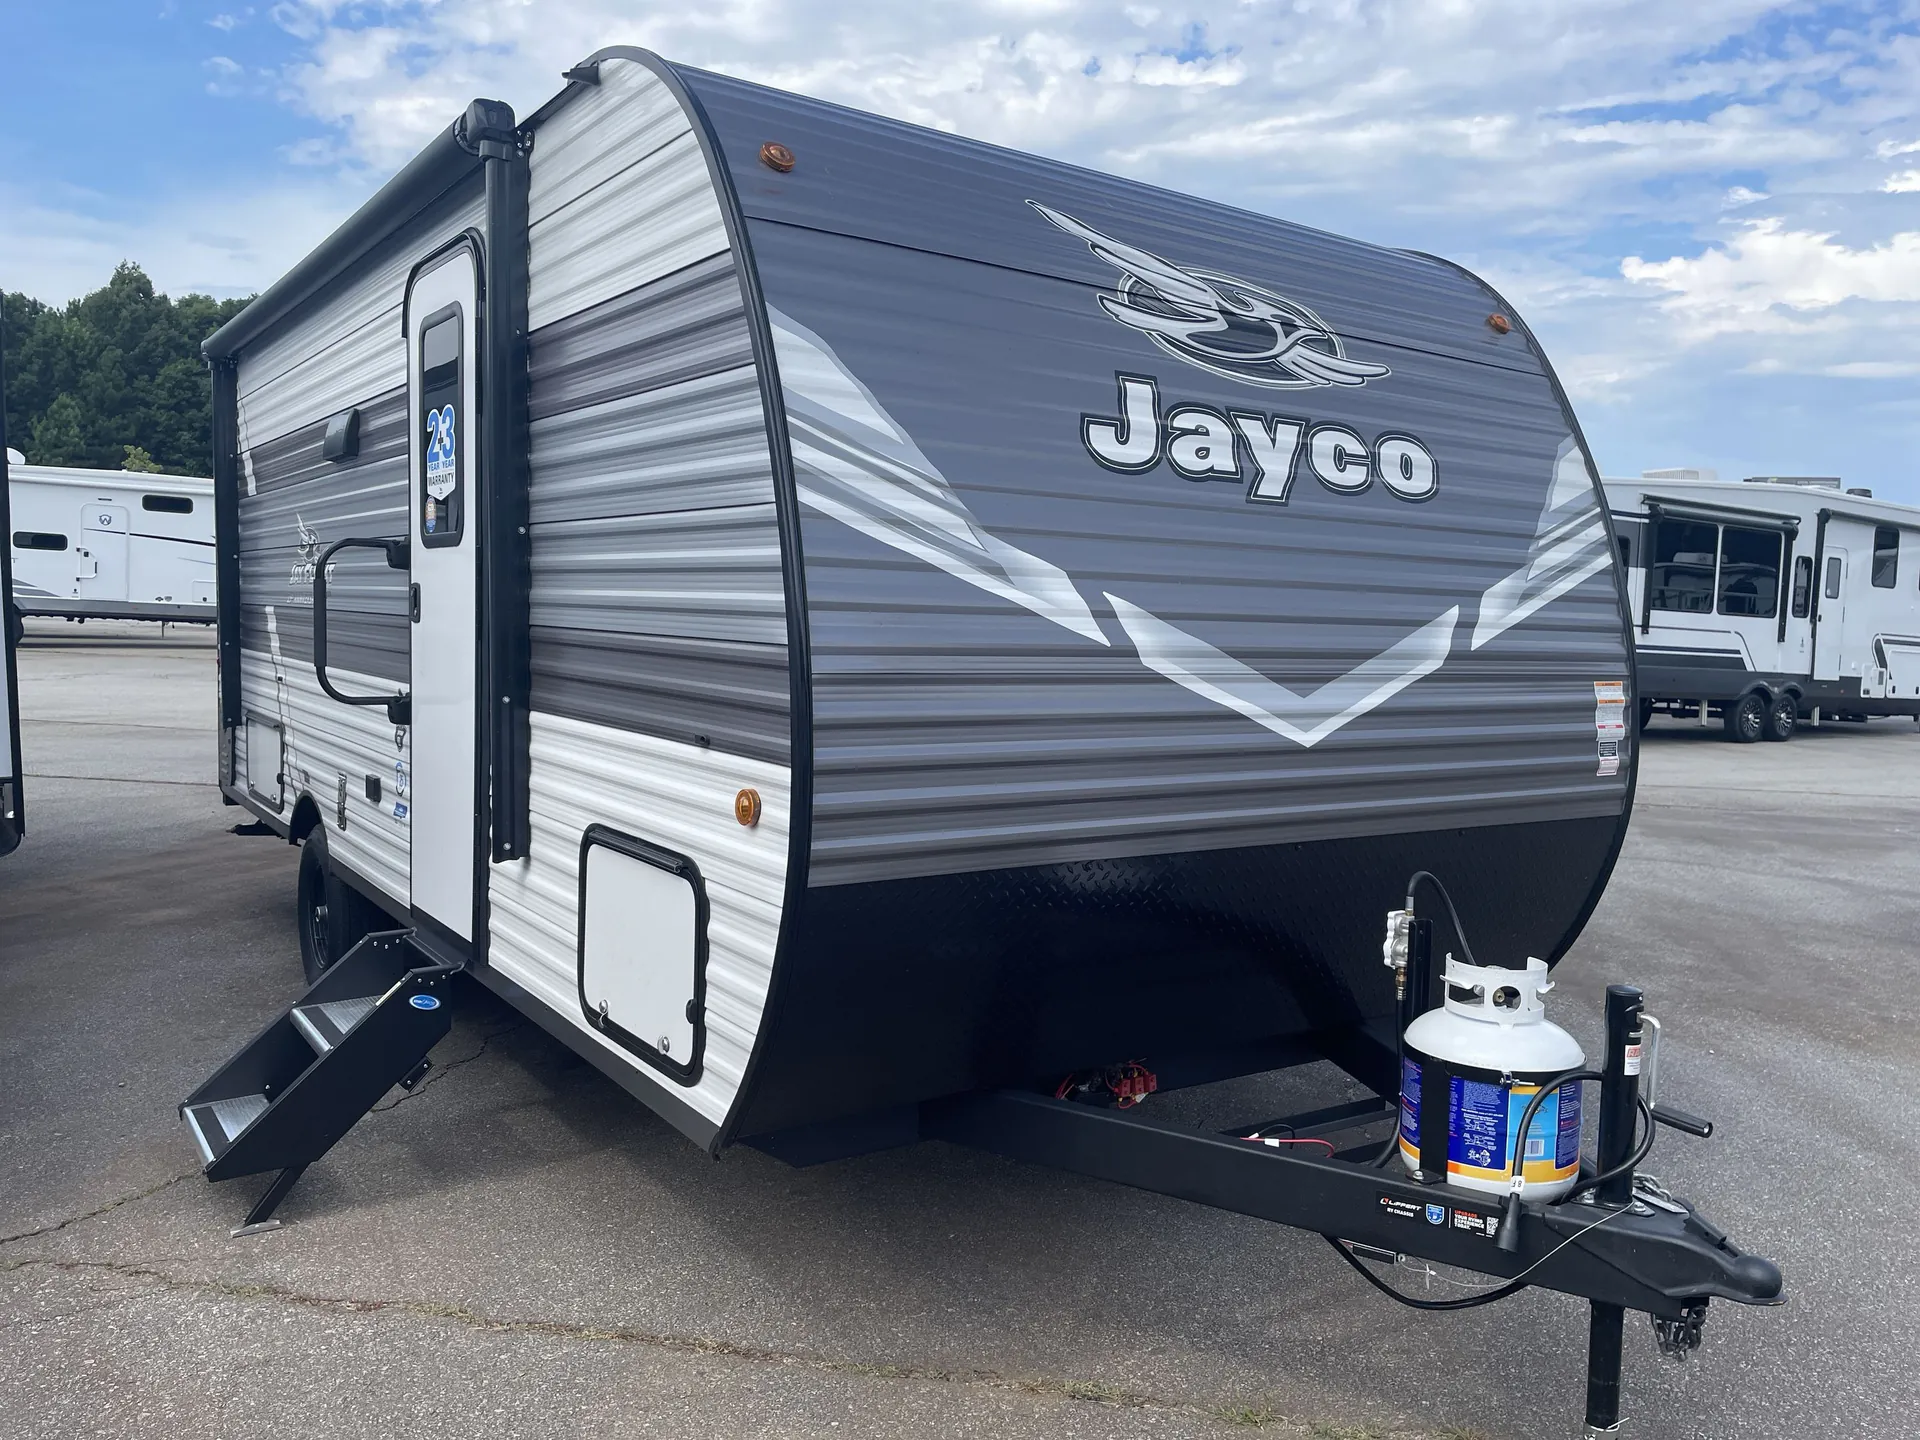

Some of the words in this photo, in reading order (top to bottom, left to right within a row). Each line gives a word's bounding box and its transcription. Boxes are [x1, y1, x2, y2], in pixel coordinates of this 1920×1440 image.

[1080, 370, 1439, 506] Jayco
[428, 462, 440, 472] YEAR
[441, 458, 454, 469] YEAR
[428, 472, 454, 487] WARRANTY
[1388, 1200, 1423, 1211] LIPPERT
[1394, 1208, 1414, 1218] CHASSIS
